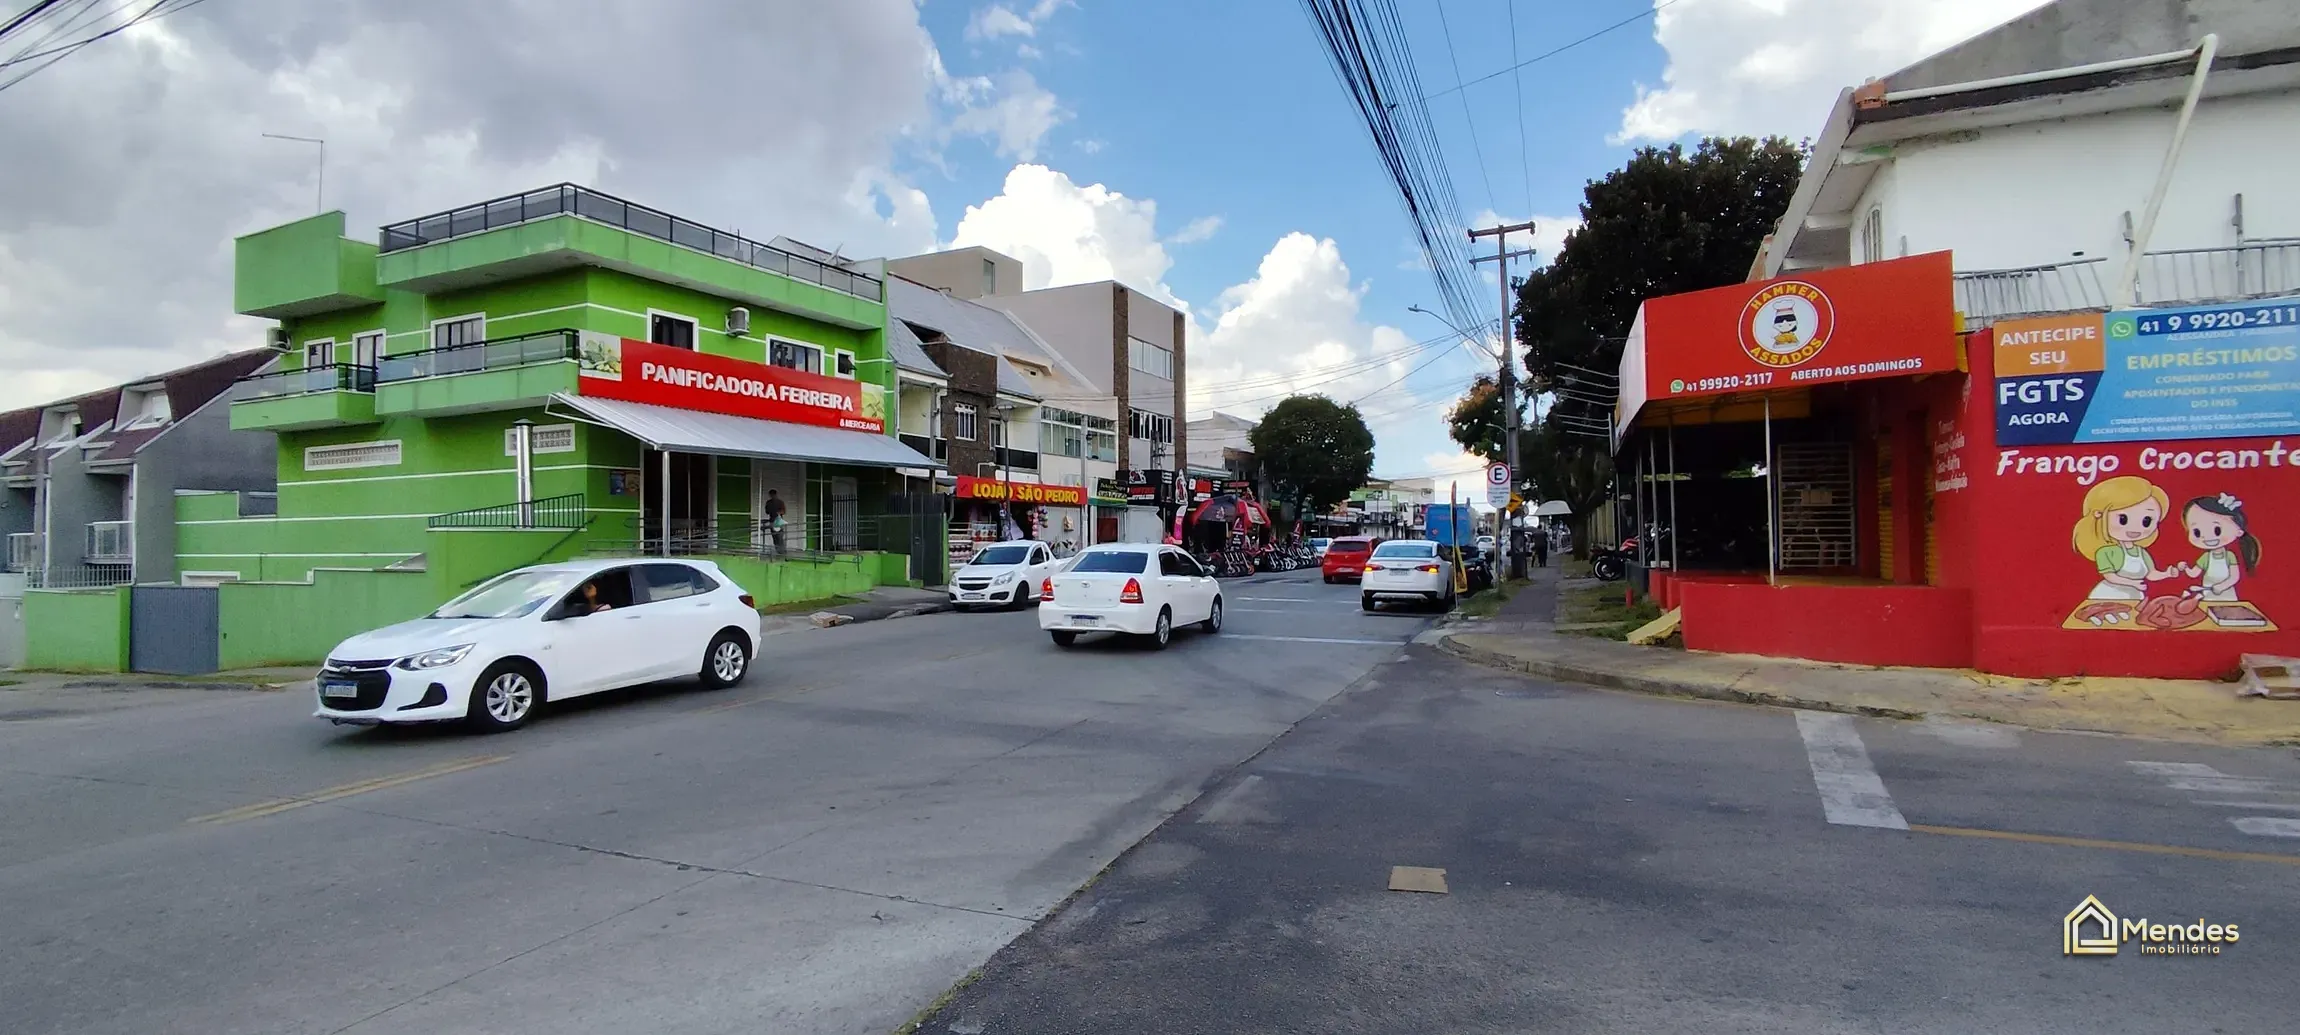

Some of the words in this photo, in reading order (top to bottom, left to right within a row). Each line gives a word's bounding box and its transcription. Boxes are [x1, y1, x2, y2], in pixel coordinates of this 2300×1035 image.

[1750, 284, 1819, 310] HAMMER
[2140, 320, 2160, 333] 41
[2167, 315, 2182, 331] 9
[2000, 326, 2096, 346] ANTECIPE
[1750, 338, 1823, 365] ASSADOS
[2029, 350, 2066, 365] SEU
[2127, 345, 2298, 370] EMPRÉSTIMOS
[1686, 382, 1698, 392] 41
[1699, 372, 1773, 391] 99920-2117
[1790, 367, 1833, 381] ABERTO
[1835, 365, 1857, 378] AOS
[1859, 357, 1923, 374] DOMINGOS
[641, 361, 777, 401] PANIFICADORA
[779, 385, 854, 412] FERREIRA
[2000, 378, 2085, 405] FGTS
[845, 419, 881, 432] MERCEARIA
[2008, 412, 2070, 427] AGORA
[1996, 449, 2120, 485] Frango
[2138, 440, 2300, 471] Crocante
[1494, 467, 1503, 481] E
[1016, 485, 1043, 502] SÃO
[1044, 489, 1080, 504] PEDRO
